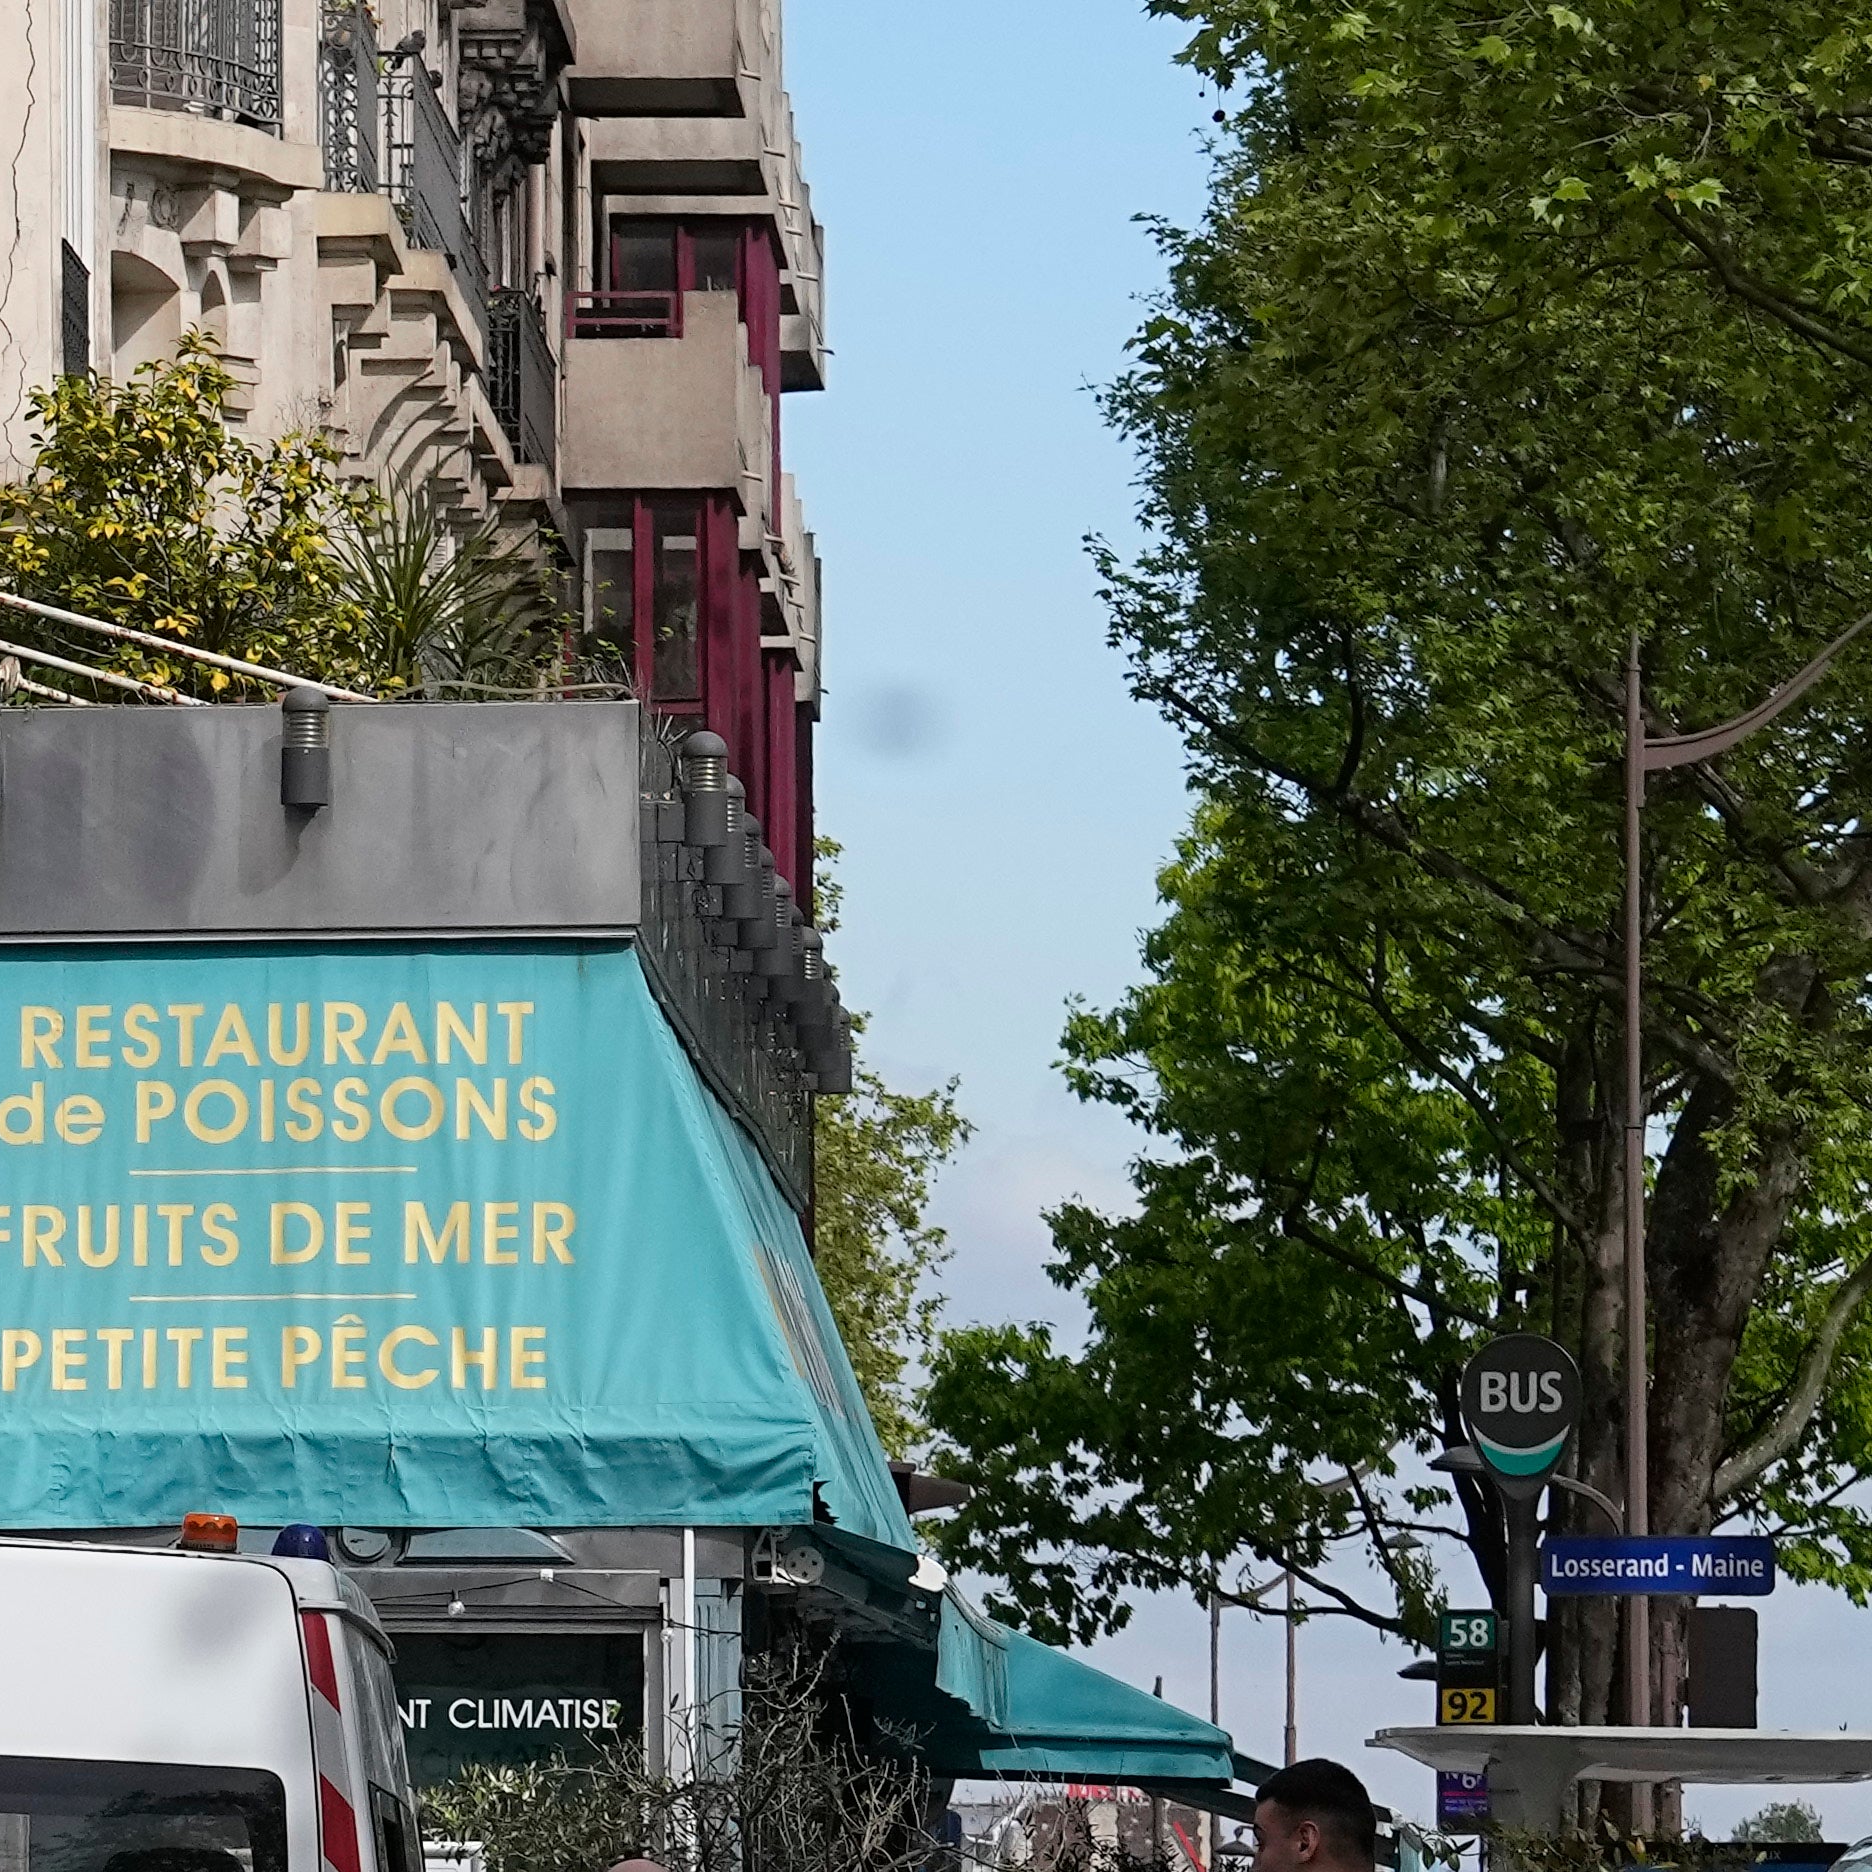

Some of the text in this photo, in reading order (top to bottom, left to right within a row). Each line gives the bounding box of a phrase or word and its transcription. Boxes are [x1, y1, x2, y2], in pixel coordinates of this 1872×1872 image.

[19, 1000, 535, 1070] RESTAURANT
[136, 1076, 559, 1145] POISSONS
[270, 1201, 371, 1266] DE
[404, 1200, 577, 1266] MER
[0, 1312, 547, 1392] PETITE PÊCHE
[1479, 1370, 1563, 1414] BUS
[1550, 1552, 1670, 1579] Losserand
[1691, 1552, 1765, 1579] Maine
[1449, 1618, 1490, 1648] 58
[447, 1697, 619, 1730] CLIMATISE
[1447, 1691, 1489, 1721] 92
